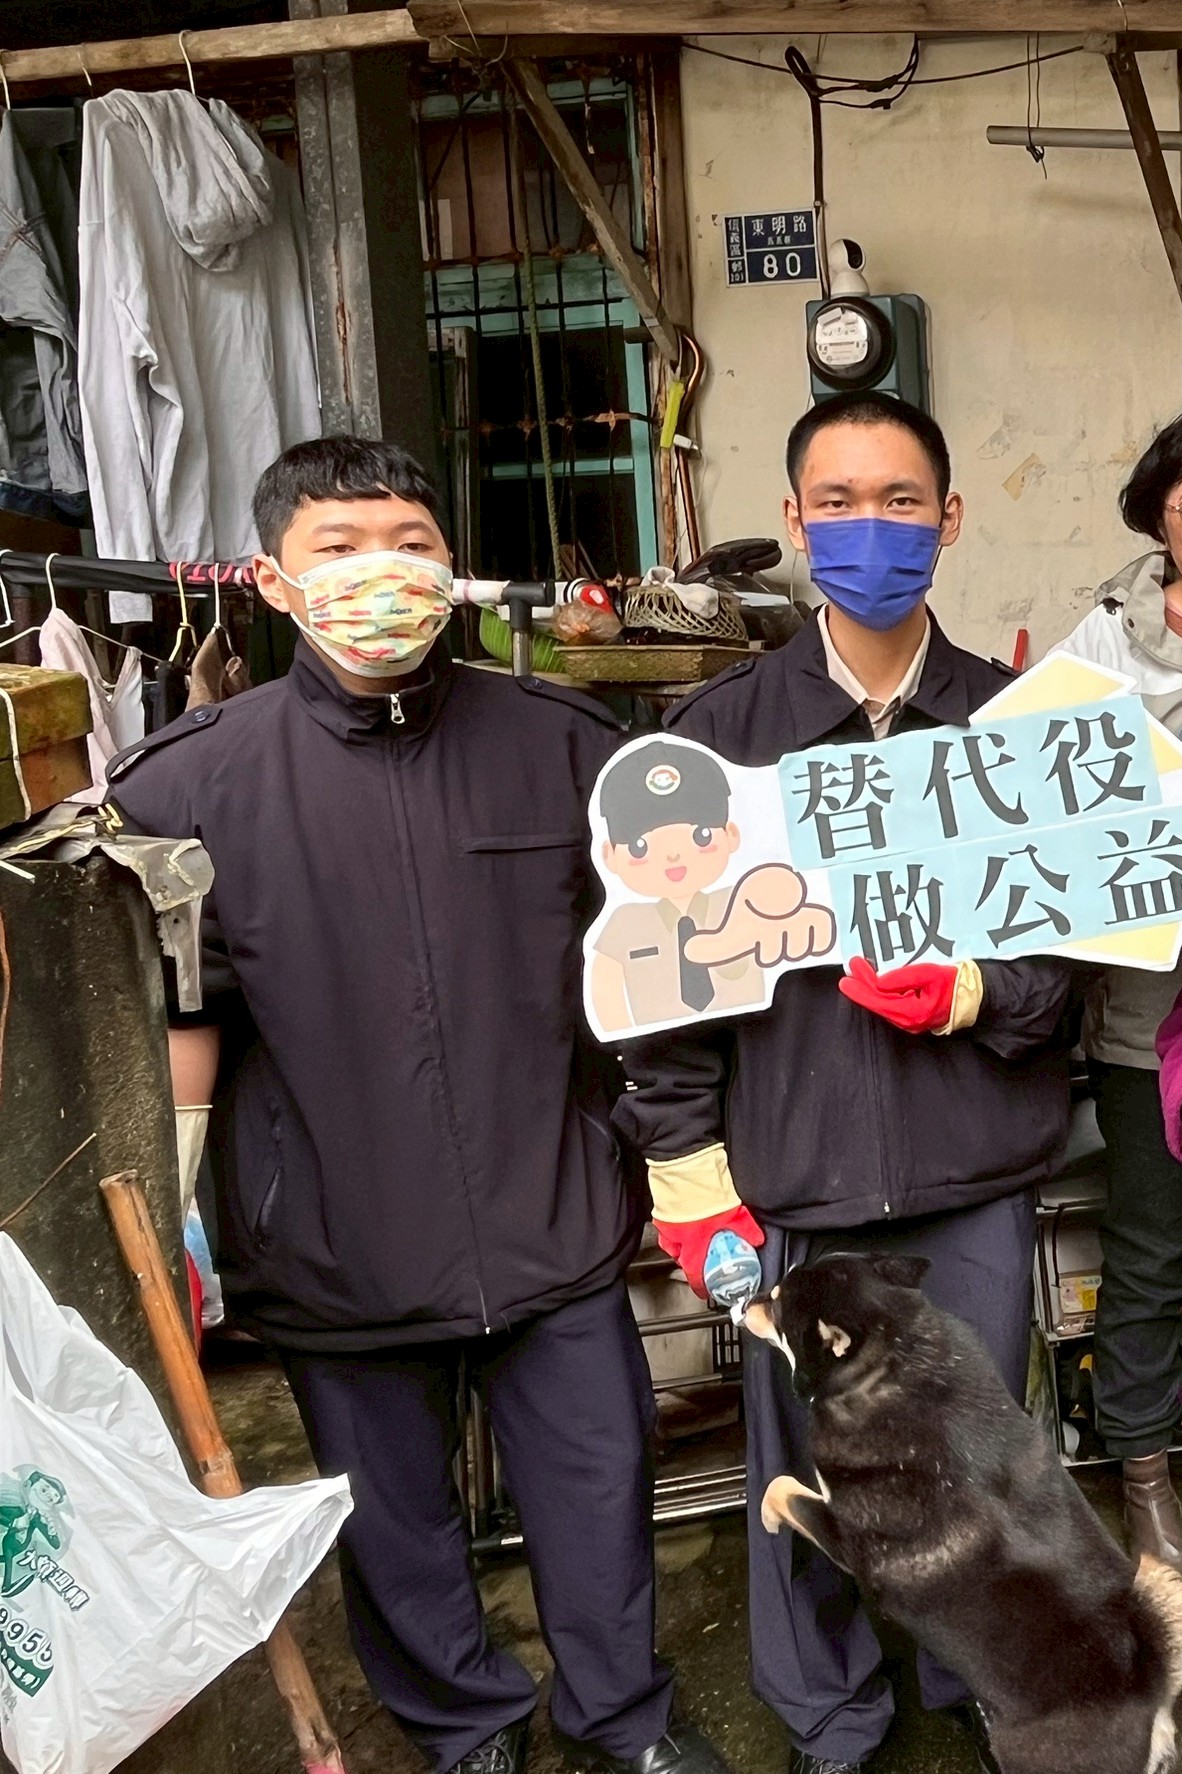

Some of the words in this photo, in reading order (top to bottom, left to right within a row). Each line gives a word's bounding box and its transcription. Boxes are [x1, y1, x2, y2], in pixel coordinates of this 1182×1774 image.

[751, 215, 807, 236] 東明路
[763, 252, 801, 278] 80
[791, 711, 1146, 859] 替代役
